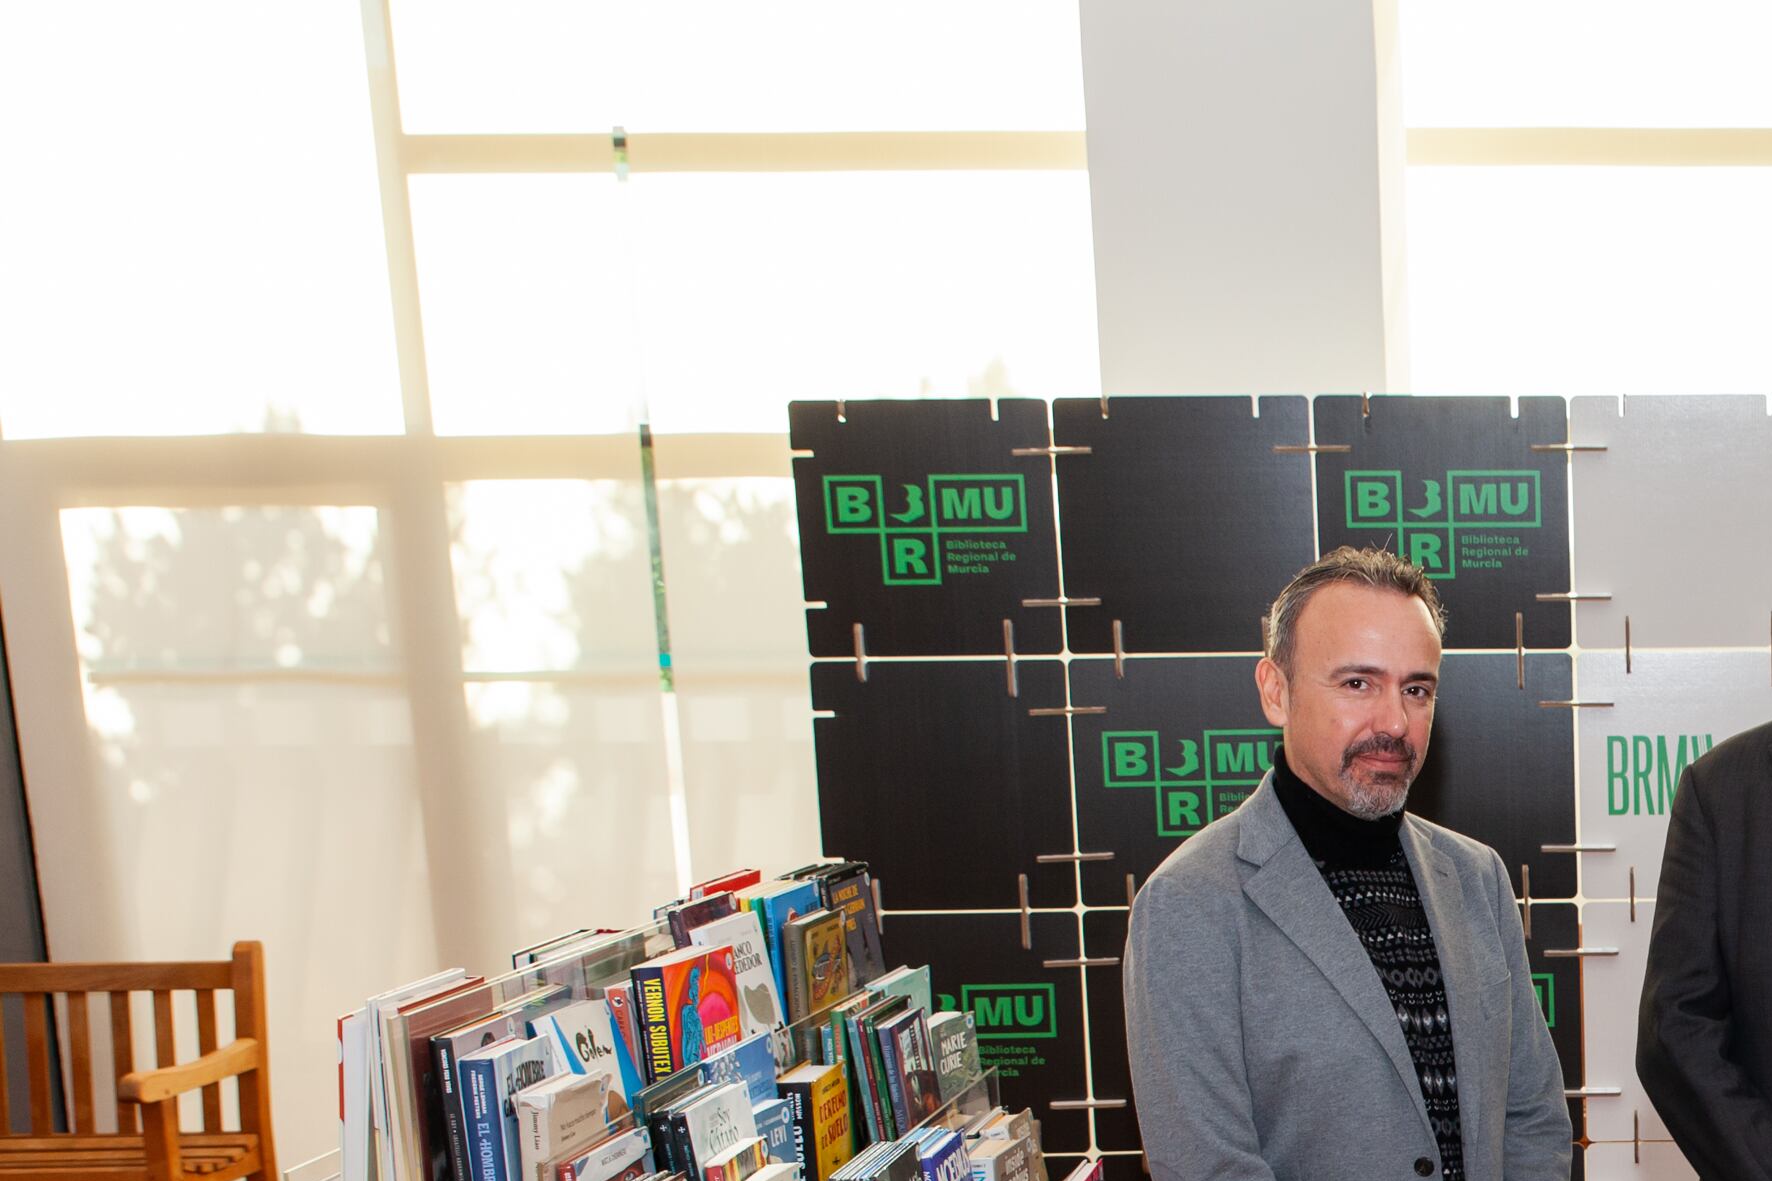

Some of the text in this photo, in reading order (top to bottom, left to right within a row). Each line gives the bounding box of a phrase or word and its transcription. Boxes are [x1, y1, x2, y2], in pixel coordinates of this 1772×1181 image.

[836, 485, 1016, 523] B MU
[1357, 481, 1529, 519] B MU
[946, 539, 1007, 551] Biblioteca
[1461, 535, 1521, 546] Biblioteca
[894, 539, 928, 574] R
[946, 551, 1017, 564] Regional de
[1411, 534, 1442, 570] R
[1461, 546, 1529, 558] Regional de
[947, 563, 989, 574] Murcia
[1461, 558, 1503, 569] Murcia
[1115, 743, 1148, 777] B
[1169, 793, 1201, 825] R
[975, 995, 1043, 1026] MU
[643, 978, 671, 1075] VERNON SUBUTEX
[941, 1033, 967, 1053] MARIE
[940, 1054, 962, 1075] CURIE
[1031, 1055, 1045, 1065] de
[477, 1122, 488, 1137] EL
[532, 1111, 542, 1150] Jimmy Liao
[770, 1125, 788, 1147] LEVI
[1005, 1148, 1025, 1170] inside
